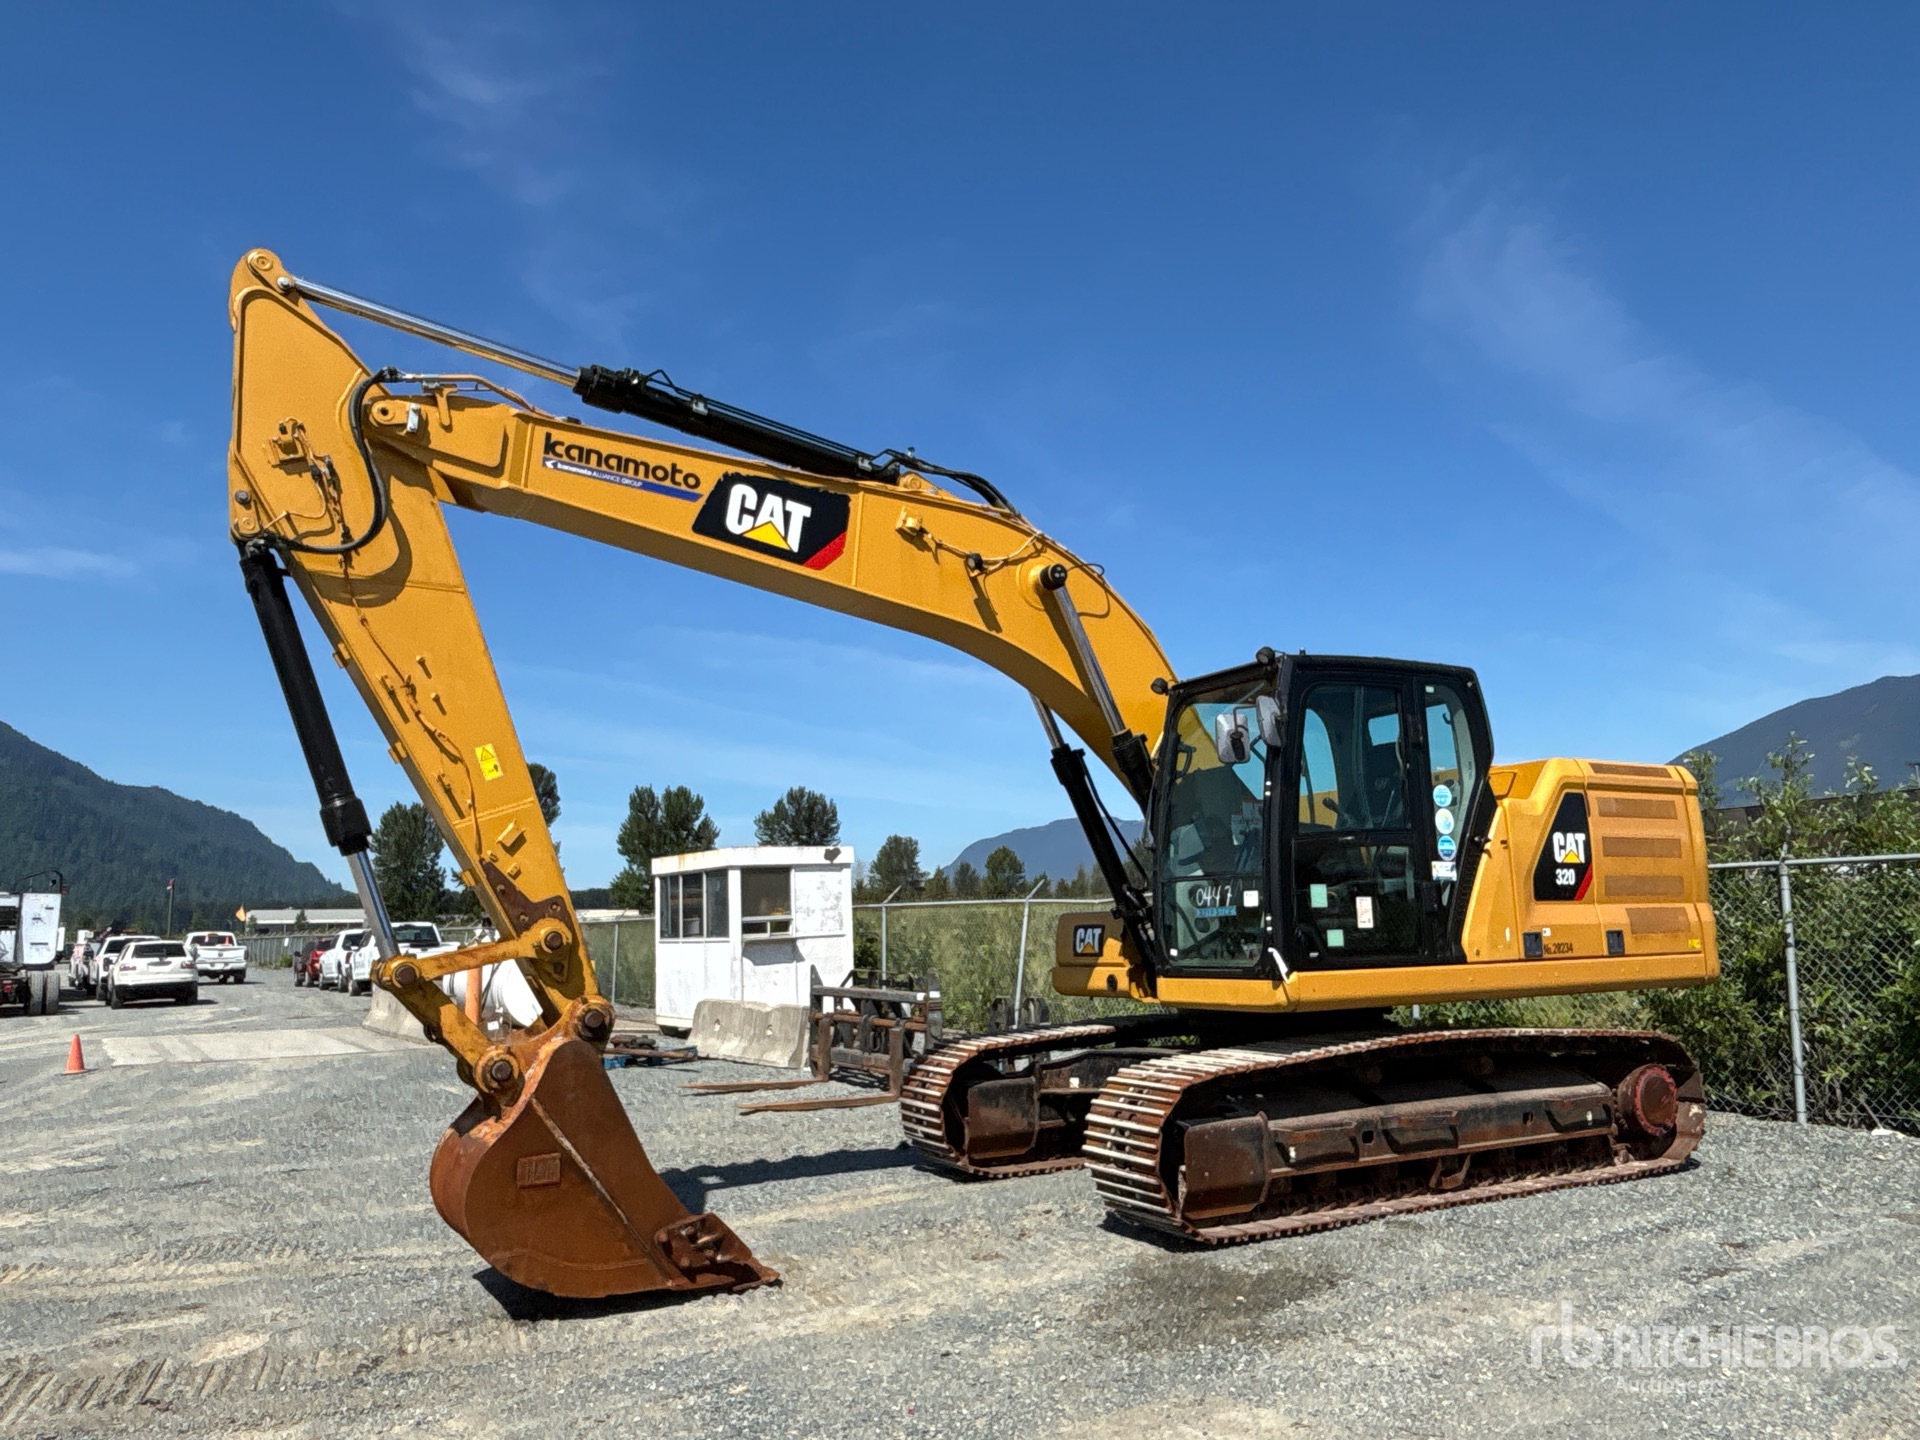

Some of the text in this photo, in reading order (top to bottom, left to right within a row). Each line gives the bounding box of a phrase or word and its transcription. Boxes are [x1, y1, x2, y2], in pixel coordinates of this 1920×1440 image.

[544, 432, 700, 490] kanamoto
[621, 476, 643, 487] GROUP
[725, 484, 812, 553] CAT
[1552, 831, 1586, 864] CAT
[1555, 869, 1576, 885] 320
[1075, 927, 1102, 954] CAT
